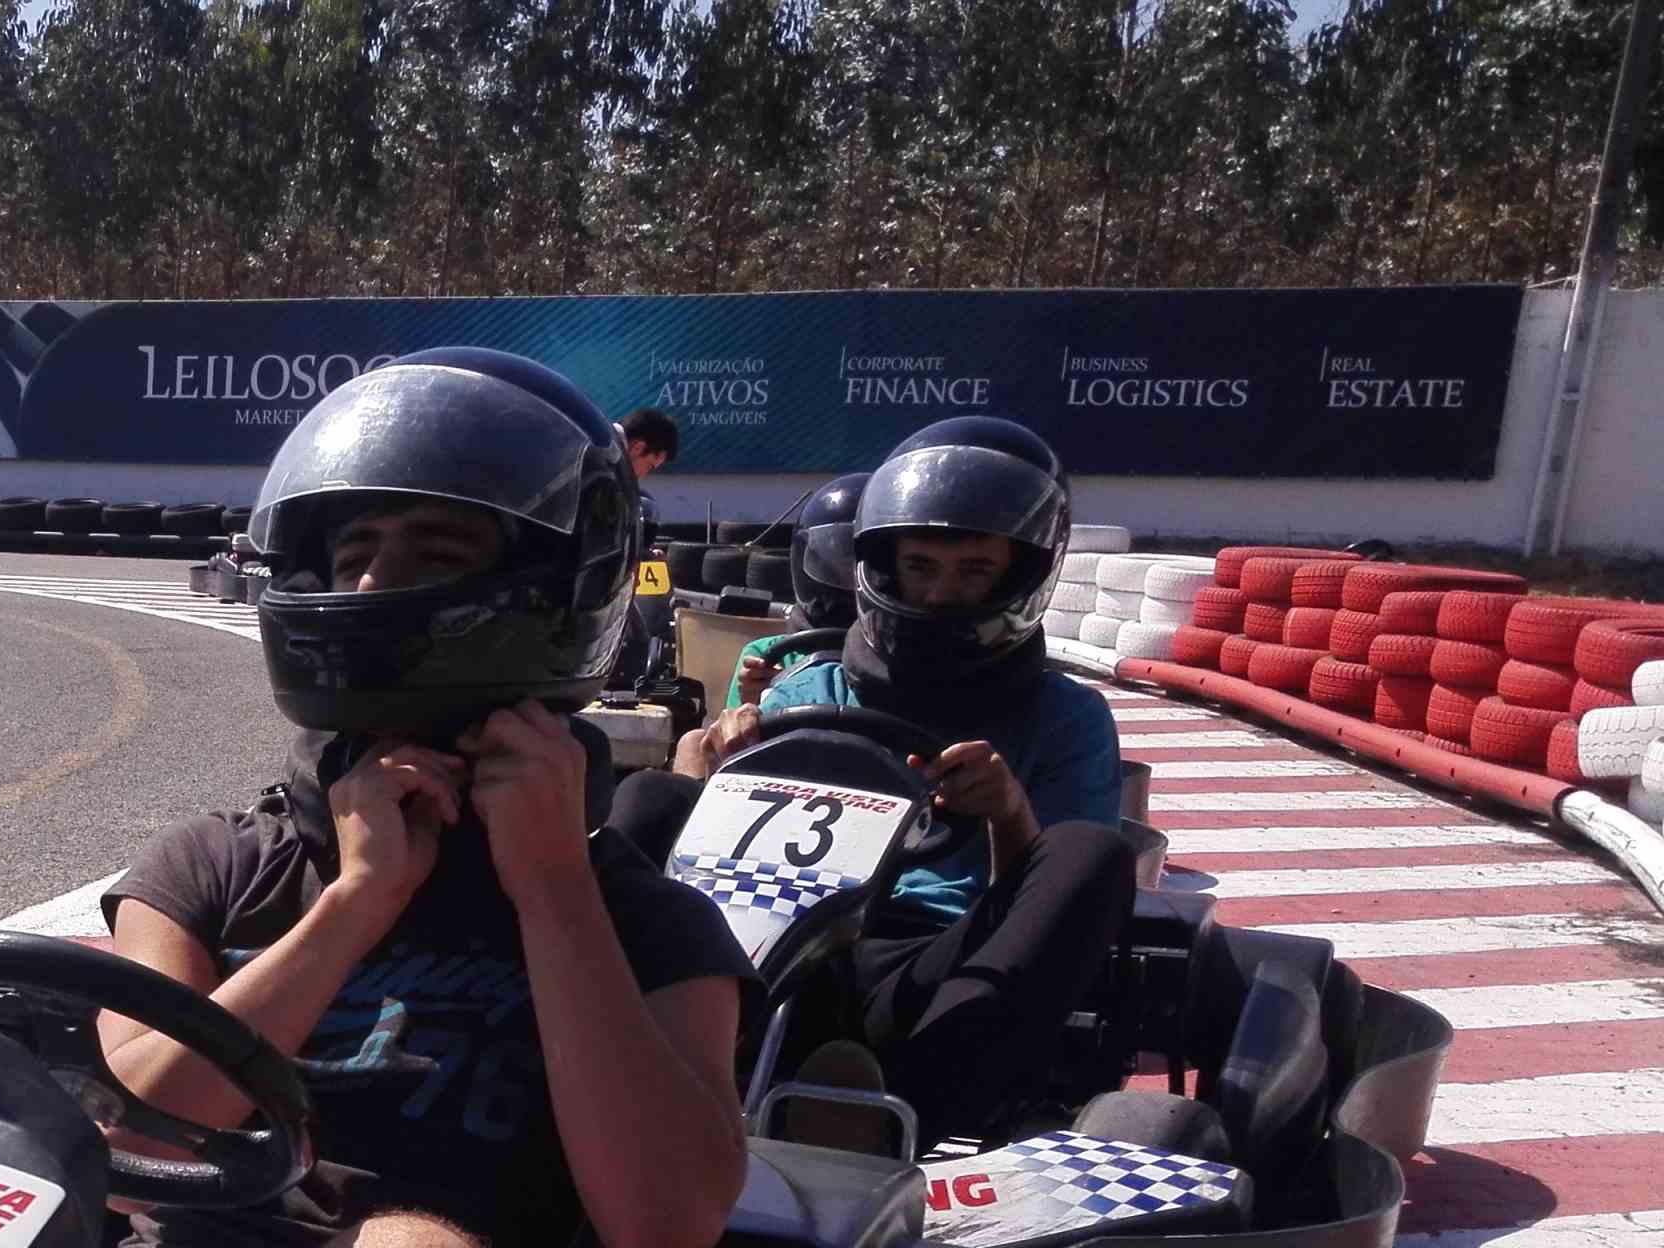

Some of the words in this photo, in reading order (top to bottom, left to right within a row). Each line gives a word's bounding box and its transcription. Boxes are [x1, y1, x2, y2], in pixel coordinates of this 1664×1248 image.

[138, 345, 398, 400] LEILOSO
[847, 356, 944, 371] CORPORATE
[1070, 357, 1148, 372] BUSINESS
[1331, 357, 1375, 372] REAL
[655, 379, 768, 406] ATIVOS
[844, 378, 990, 405] FINANCE
[1067, 378, 1248, 406] LOGISTICS
[1327, 380, 1465, 408] ESTATE
[730, 789, 844, 867] 73
